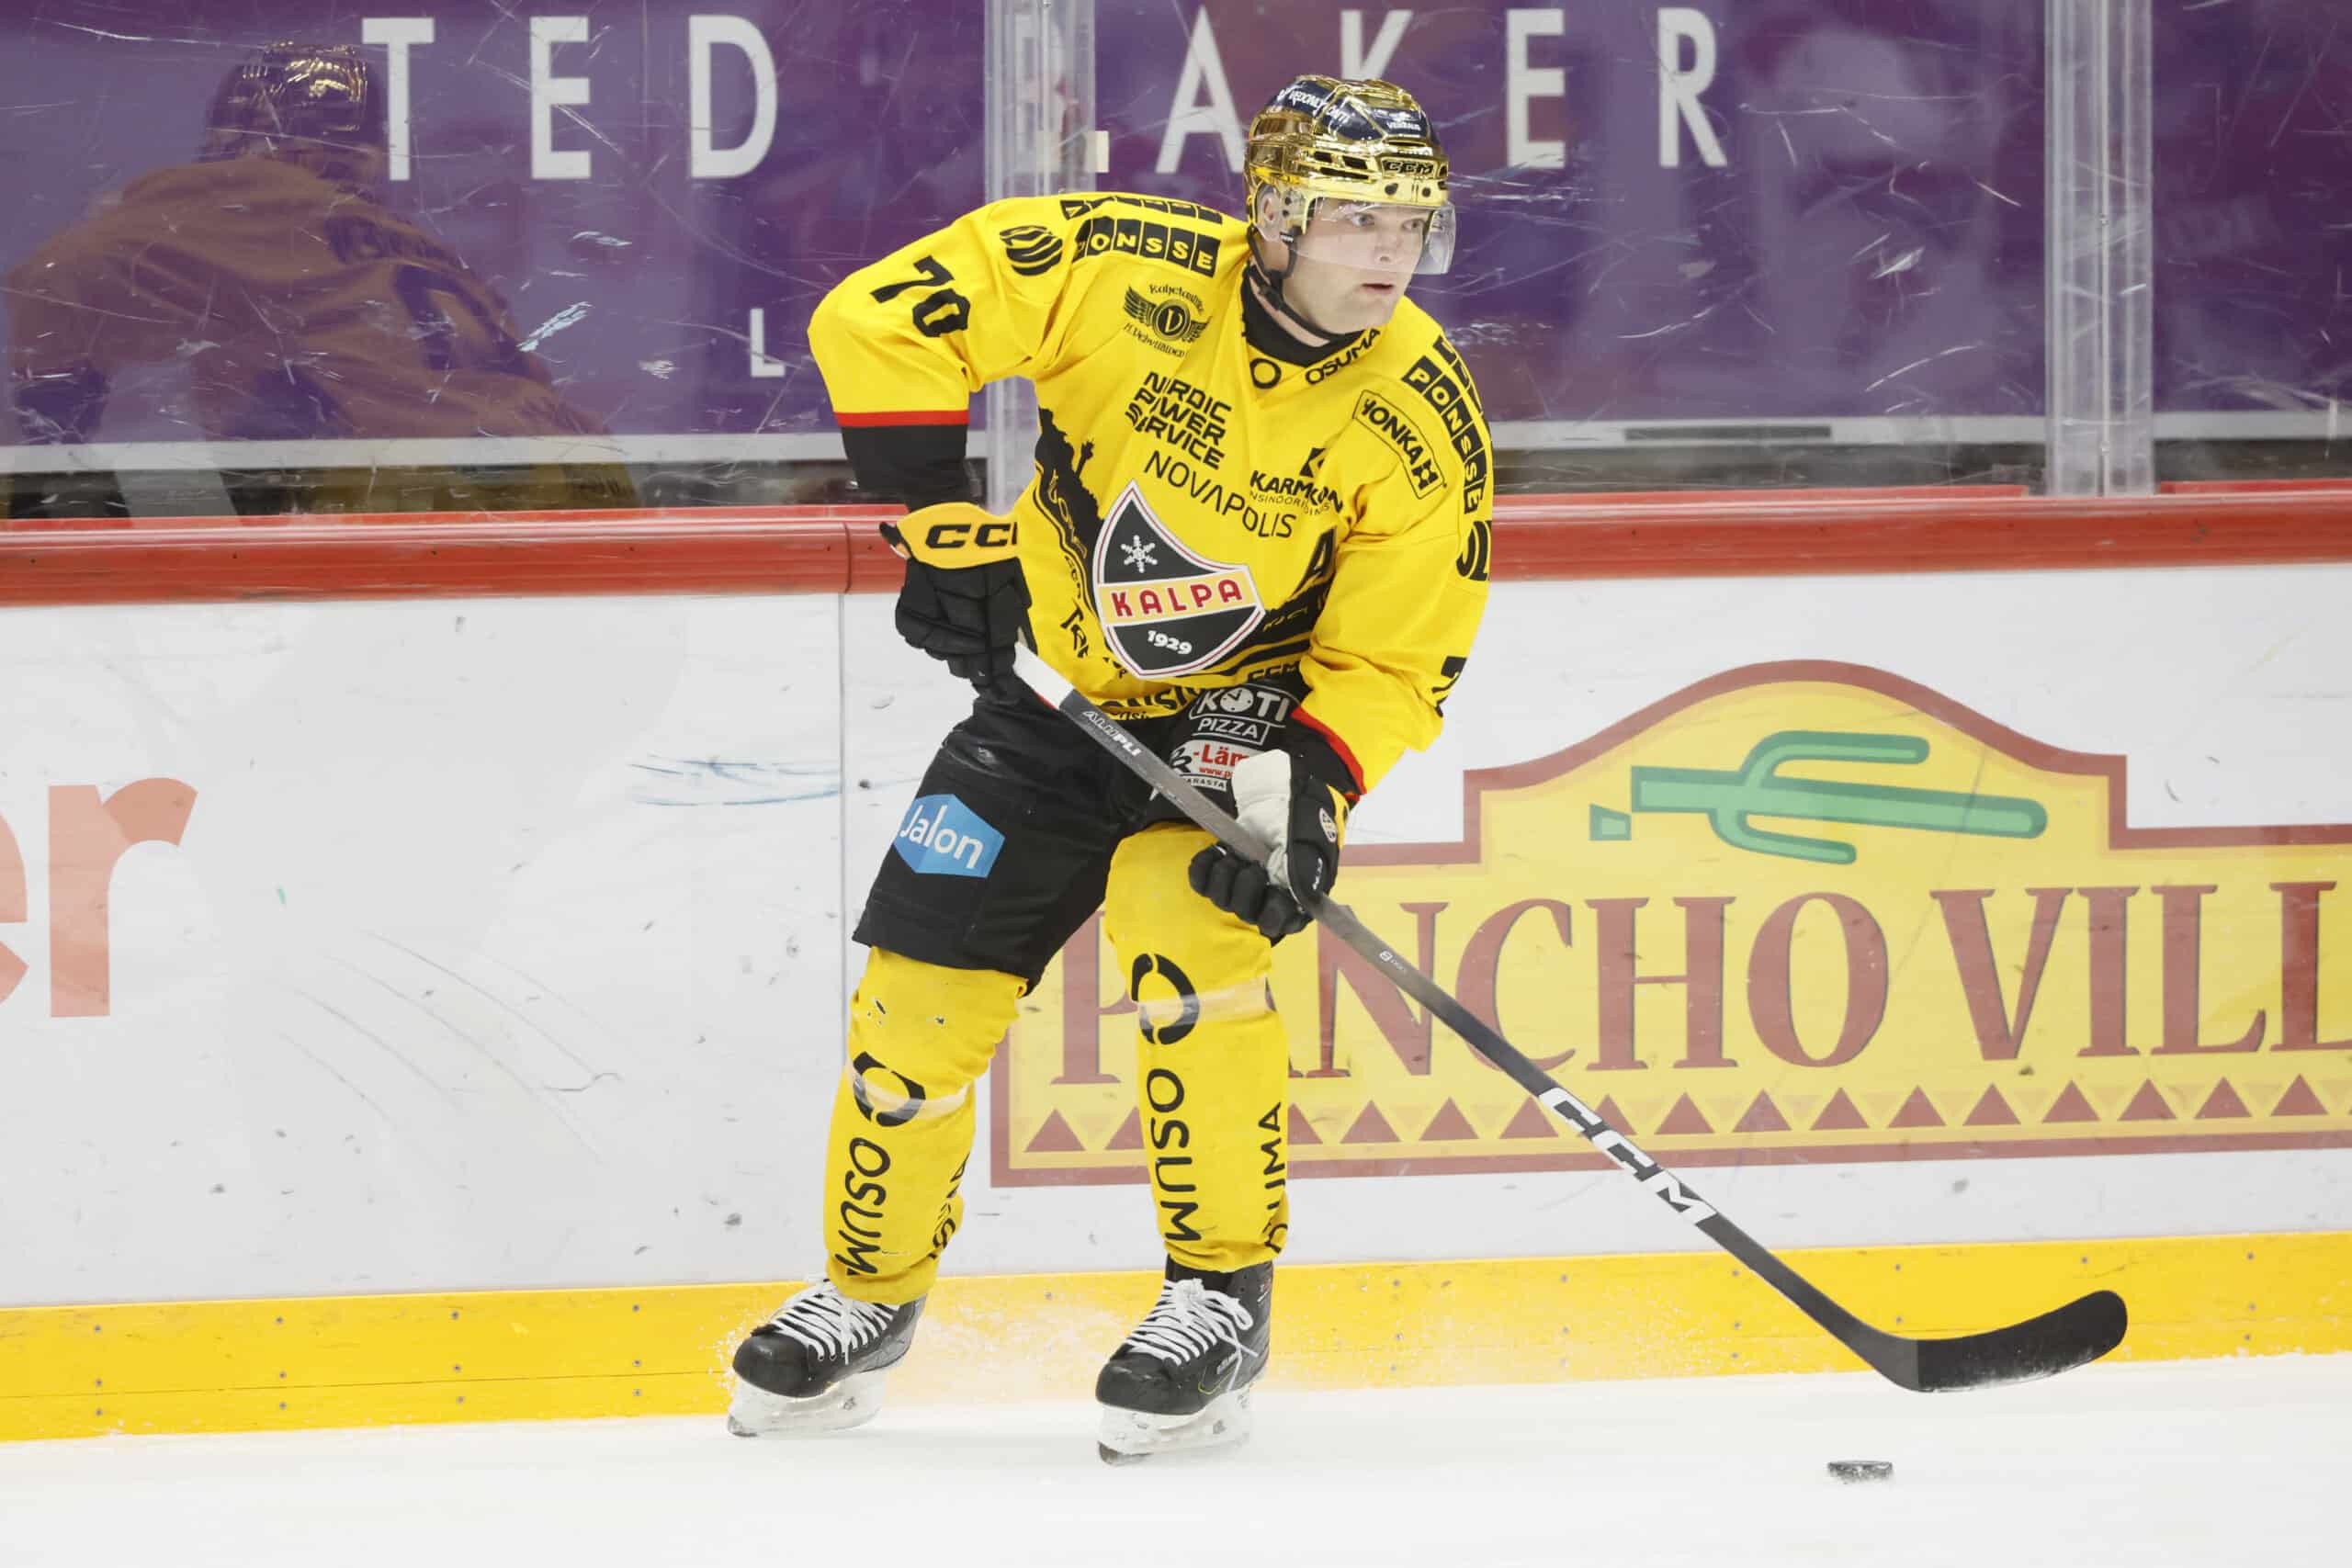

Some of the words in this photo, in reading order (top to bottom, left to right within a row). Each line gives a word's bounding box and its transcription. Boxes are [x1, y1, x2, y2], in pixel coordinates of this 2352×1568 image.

[362, 16, 778, 181] TED
[1075, 226, 1215, 273] ONSSE
[869, 255, 970, 337] 70
[1305, 328, 1381, 385] OSUMA
[1134, 387, 1227, 446] PWER
[1143, 372, 1232, 424] NRDIC
[1407, 365, 1484, 513] PONSSE
[1143, 450, 1297, 538] NOVAPOLIS
[925, 522, 1018, 549] CC
[1110, 579, 1243, 618] KALPA
[1147, 630, 1193, 656] 1929
[1196, 687, 1290, 722] KOTI
[1197, 717, 1259, 739] PIZZA
[1050, 891, 1889, 1086] PNCHO
[1538, 1088, 1719, 1225] CCM
[834, 1137, 891, 1276] OSUM
